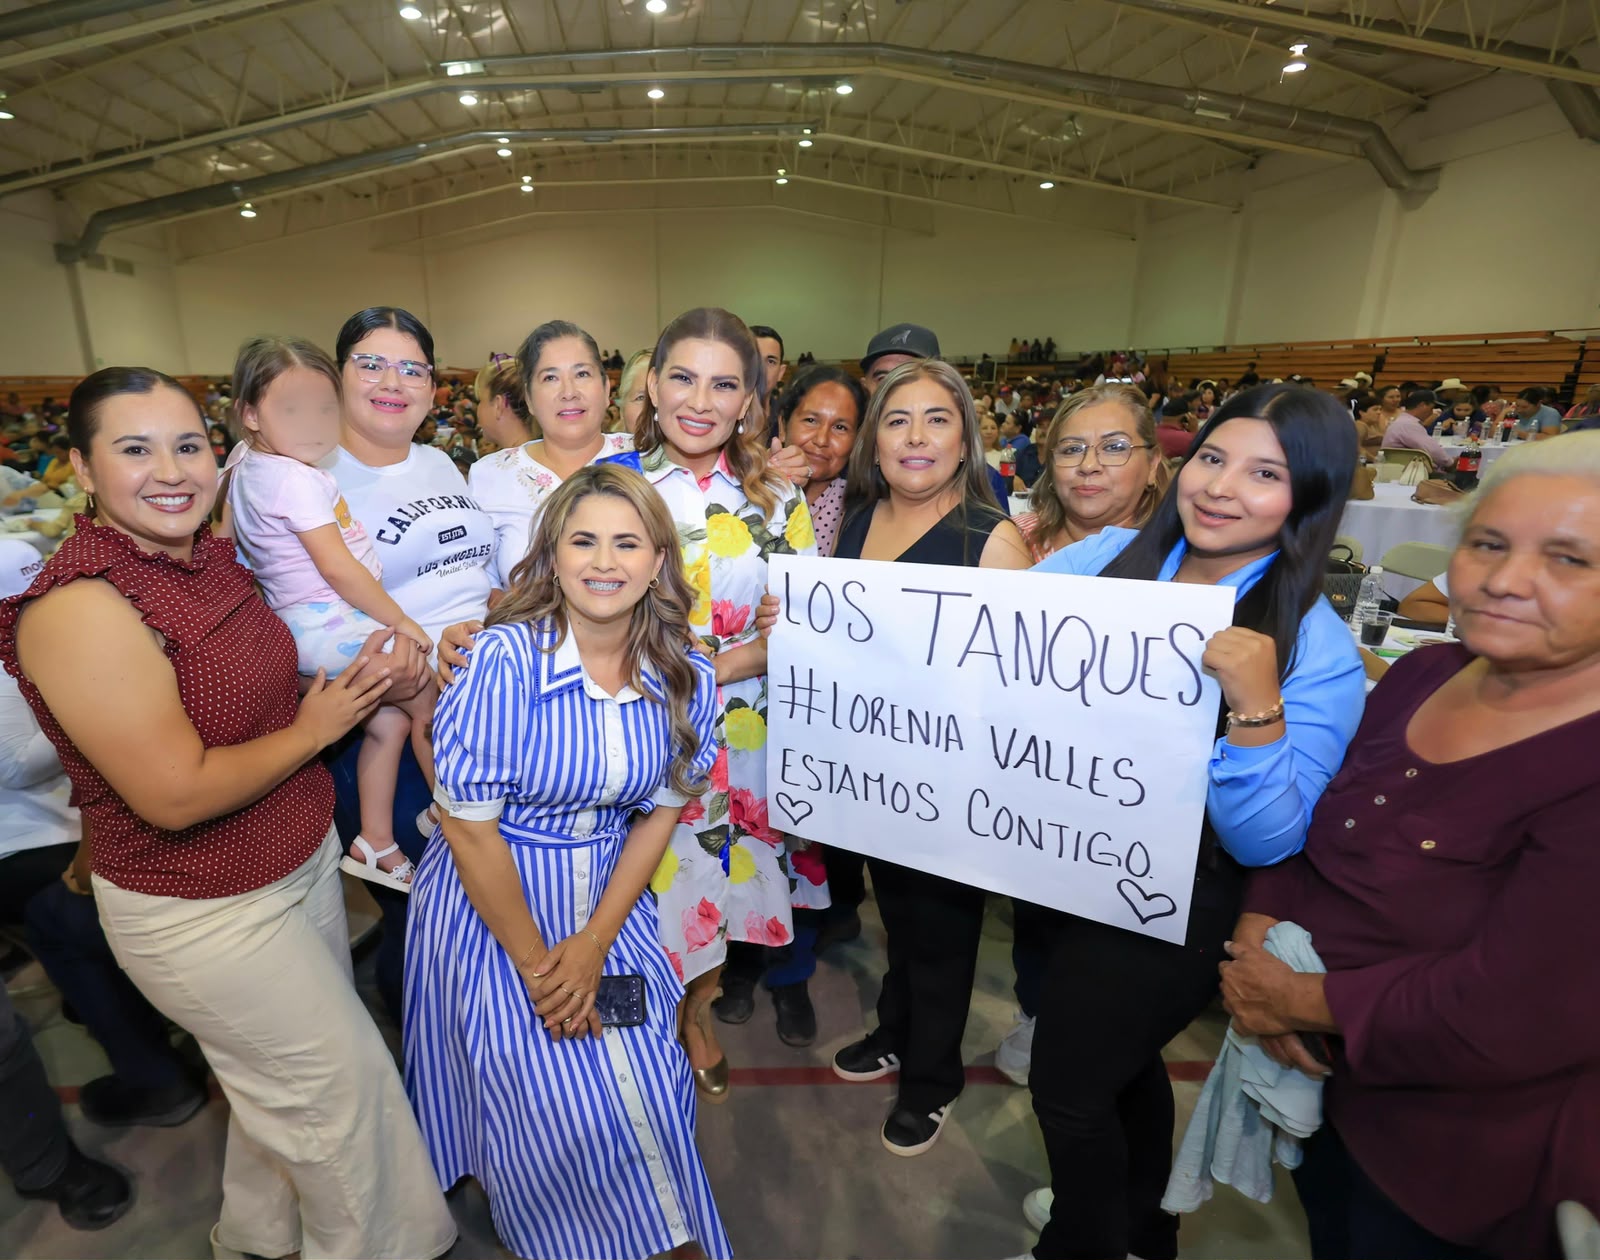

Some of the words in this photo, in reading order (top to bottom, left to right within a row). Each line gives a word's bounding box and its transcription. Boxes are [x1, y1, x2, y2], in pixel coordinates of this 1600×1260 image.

[416, 560, 438, 577] LOS
[442, 543, 491, 566] ANGELES
[435, 563, 463, 578] United
[784, 571, 874, 643] LOS
[900, 587, 1206, 708] TANQUES
[777, 664, 964, 753] #LORENIA
[990, 725, 1146, 807] VALLES
[780, 748, 940, 822] ESTAMOS
[966, 788, 1155, 880] CONTIGO.
